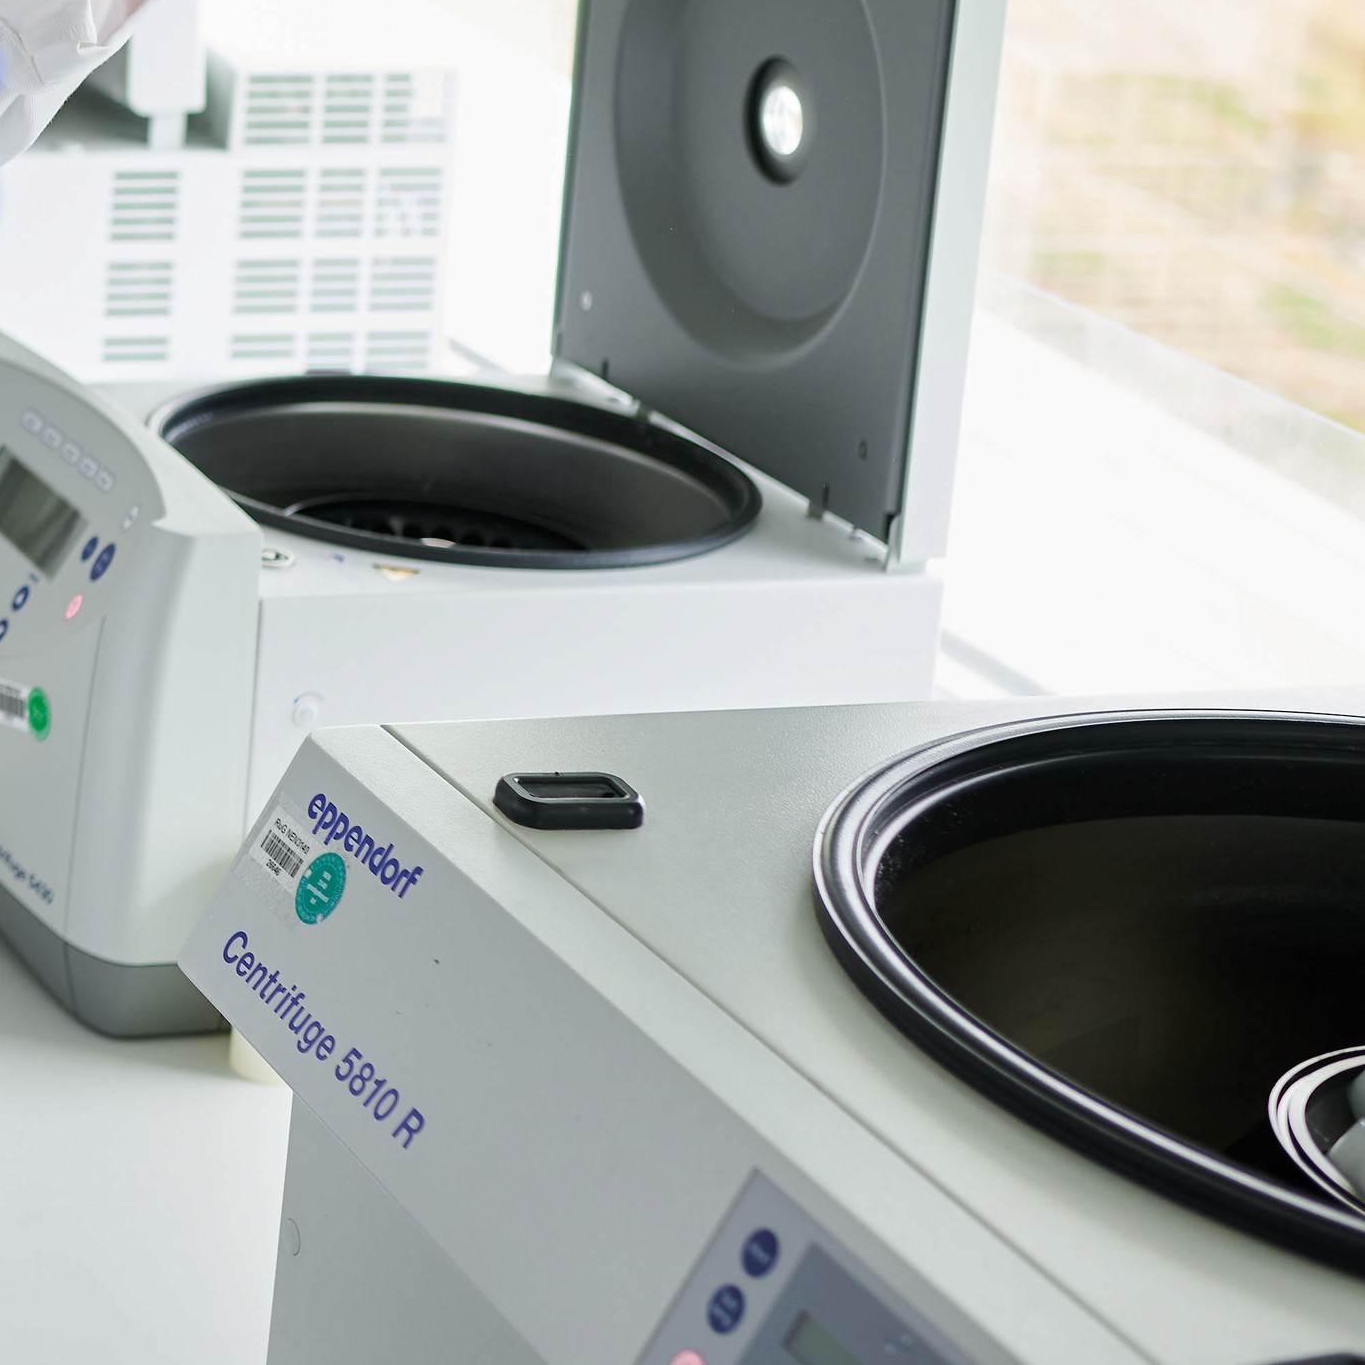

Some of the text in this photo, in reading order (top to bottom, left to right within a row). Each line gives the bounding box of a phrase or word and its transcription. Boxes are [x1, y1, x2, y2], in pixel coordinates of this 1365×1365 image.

[274, 818, 288, 834] RuG
[307, 793, 424, 899] eppendorf
[222, 931, 426, 1149] Centrifuge 5810 R
